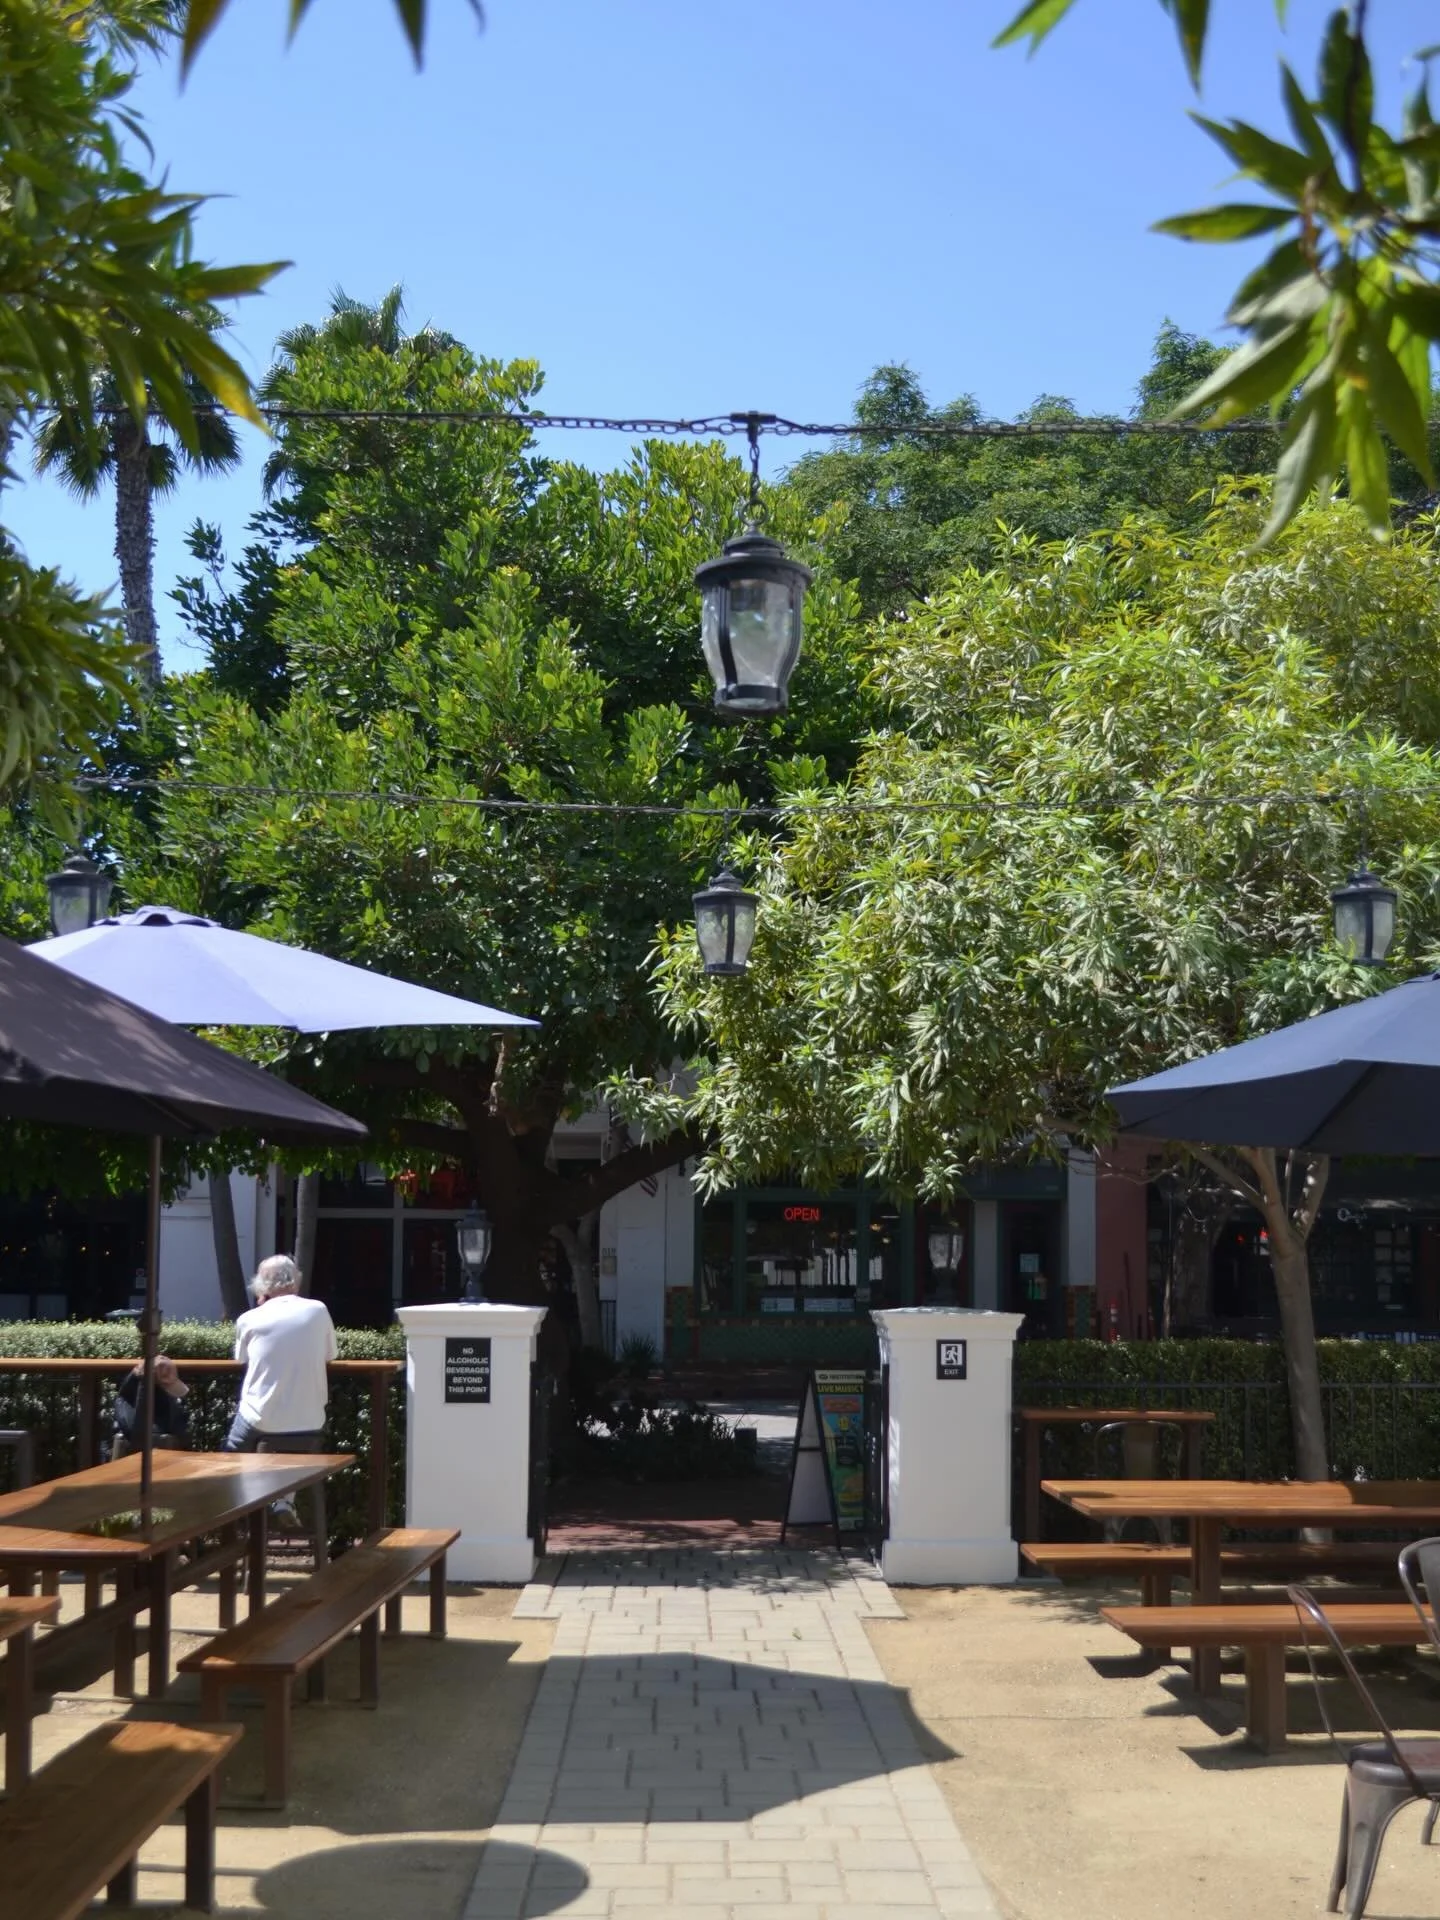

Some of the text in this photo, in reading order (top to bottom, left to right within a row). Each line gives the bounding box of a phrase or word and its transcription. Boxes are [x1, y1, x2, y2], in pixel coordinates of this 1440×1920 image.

[783, 1207, 819, 1221] OPEN
[462, 1347, 474, 1355] NO
[452, 1376, 484, 1384] BEYOND
